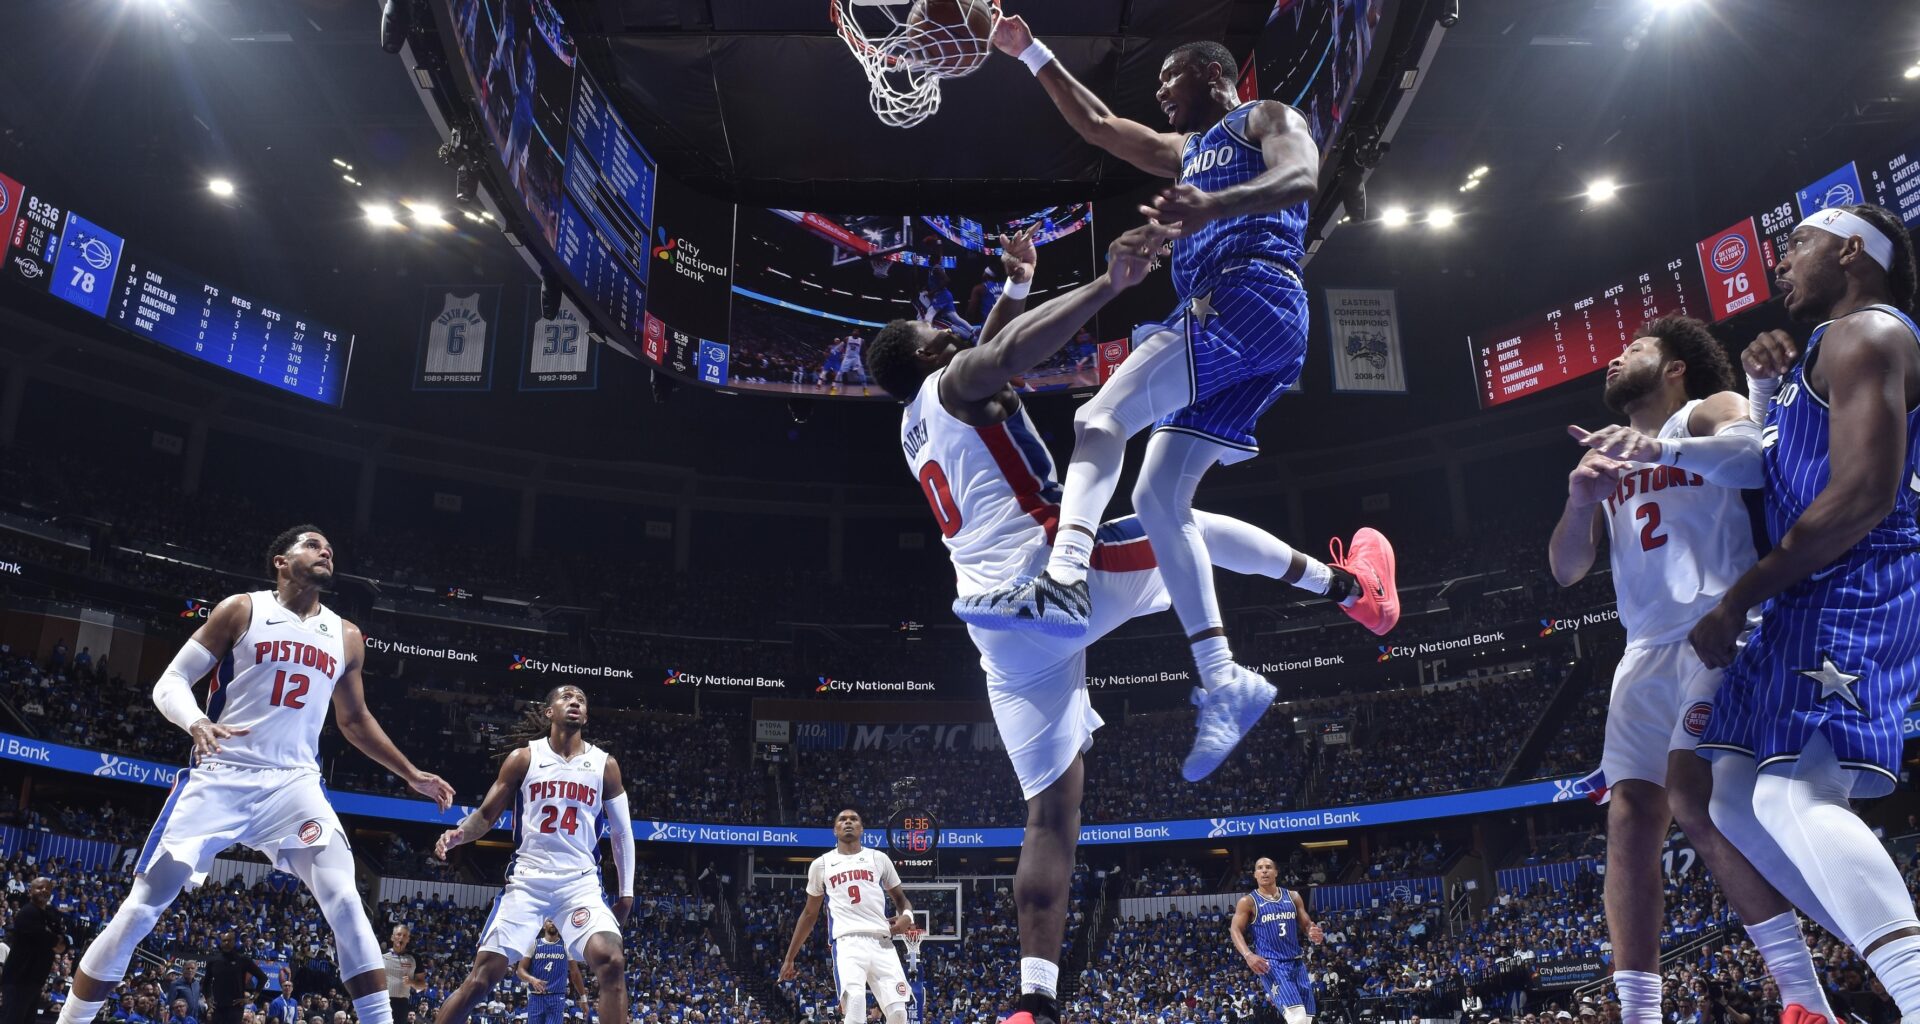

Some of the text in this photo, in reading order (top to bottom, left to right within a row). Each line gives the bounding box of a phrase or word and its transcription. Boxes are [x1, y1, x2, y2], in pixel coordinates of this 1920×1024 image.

[1872, 153, 1907, 180] 8 CAIN
[1875, 161, 1920, 192] 34 CARTER
[1801, 191, 1807, 199] 8
[1879, 175, 1920, 205] 5 BANCH
[28, 196, 60, 222] 8:36
[1761, 202, 1792, 227] 8:36
[27, 211, 56, 230] 4TH QTR
[70, 216, 77, 224] 8
[1765, 216, 1794, 235] 4TH QTR
[30, 235, 41, 247] TOL
[32, 227, 44, 238] FLS
[1763, 232, 1788, 250] 2 FLS
[27, 244, 40, 256] CHL
[677, 238, 700, 257] City
[1718, 244, 1740, 258] DETROIT
[1720, 250, 1741, 264] PISTONS
[1766, 251, 1771, 259] 2
[676, 250, 727, 276] National
[676, 262, 705, 283] Bank
[70, 266, 96, 293] 78
[1723, 272, 1749, 298] 76
[128, 275, 137, 286] 34
[143, 282, 168, 300] CARTER
[168, 294, 178, 304] JR.
[202, 308, 210, 318] 10
[1547, 259, 1682, 321] PTS REBS ASTS FG FLS
[130, 264, 304, 342] 8 CAIN 2/7
[203, 284, 337, 342] PTS REBS ASTS FG FLS
[1334, 309, 1391, 317] CONFERENCE
[1729, 296, 1752, 310] BONUS
[125, 287, 130, 295] 5
[140, 294, 175, 315] BANCHERO
[287, 353, 302, 364] 3/15
[1338, 319, 1388, 327] CHAMPIONS
[1482, 284, 1652, 356] 24 JENKINS 1/5
[1498, 295, 1654, 362] DUREN 12 5/7
[123, 299, 298, 375] 4 SUGGS 0/8
[447, 323, 466, 355] 6
[542, 324, 579, 356] 32
[648, 338, 657, 353] 76
[674, 332, 688, 343] 8:36
[1485, 306, 1658, 378] 12 HARRIS 15 6/14
[120, 311, 298, 386] 3 BANE 19 6/13
[706, 364, 719, 376] 78
[1502, 355, 1566, 384] CUNNINGHAM 23
[1504, 377, 1538, 395] THOMPSON
[902, 418, 929, 461] DUREN
[918, 460, 963, 539] 0
[1636, 501, 1668, 551] 2
[0, 561, 22, 575] ank
[1554, 610, 1619, 630] City Natio
[365, 637, 478, 663] City National Bank
[1391, 631, 1505, 658] City National Bank
[254, 640, 337, 680] PISTONS
[524, 658, 634, 679] City National Bank
[1262, 658, 1312, 673] National
[1314, 654, 1344, 668] Bank
[678, 673, 786, 688] City National Bank
[830, 680, 936, 692] City National Bank
[1084, 670, 1190, 688] City National Bank
[270, 670, 310, 710] 12
[796, 724, 827, 737] 110A
[8, 741, 50, 762] Bank
[117, 761, 150, 783] City
[529, 780, 597, 806] PISTONS
[540, 805, 579, 835] 24
[904, 818, 928, 829] 8:36
[1226, 811, 1361, 834] City National Bank
[667, 826, 798, 843] City National Bank
[863, 832, 983, 846] ity Bank
[1134, 826, 1170, 839] Bank
[829, 870, 874, 888] PISTONS
[848, 885, 861, 904] 9
[1278, 922, 1286, 936] 3
[544, 962, 553, 972] 4
[1540, 963, 1600, 976] City National Bank
